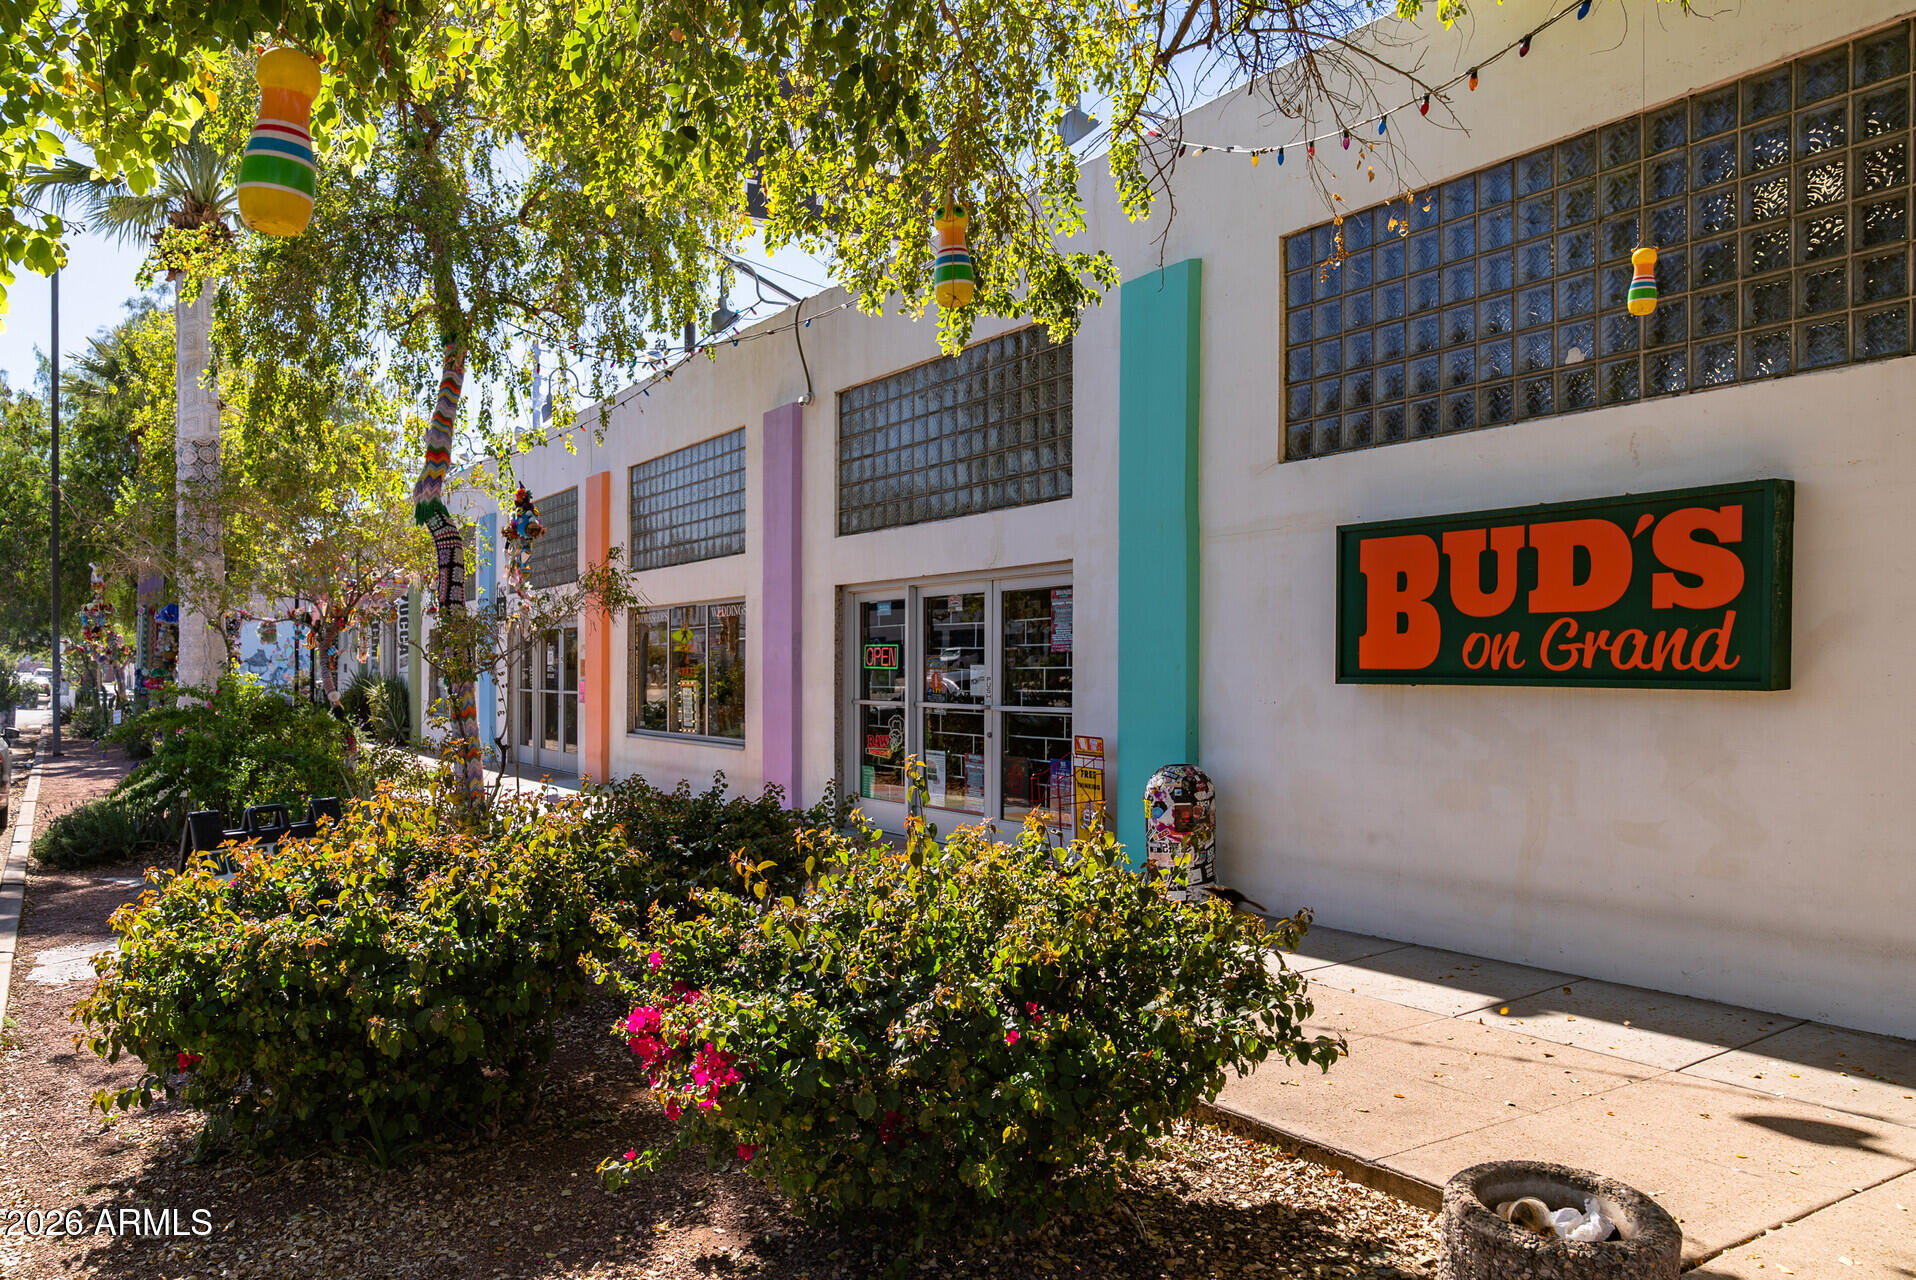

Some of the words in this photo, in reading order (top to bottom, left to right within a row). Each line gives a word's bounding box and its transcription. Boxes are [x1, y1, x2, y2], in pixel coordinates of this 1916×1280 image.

[1358, 505, 1745, 670] BUD'S
[1461, 631, 1526, 670] on
[1540, 610, 1740, 672] Grand
[866, 647, 896, 666] OPEN
[867, 734, 890, 749] RAW
[1080, 770, 1096, 778] FREE
